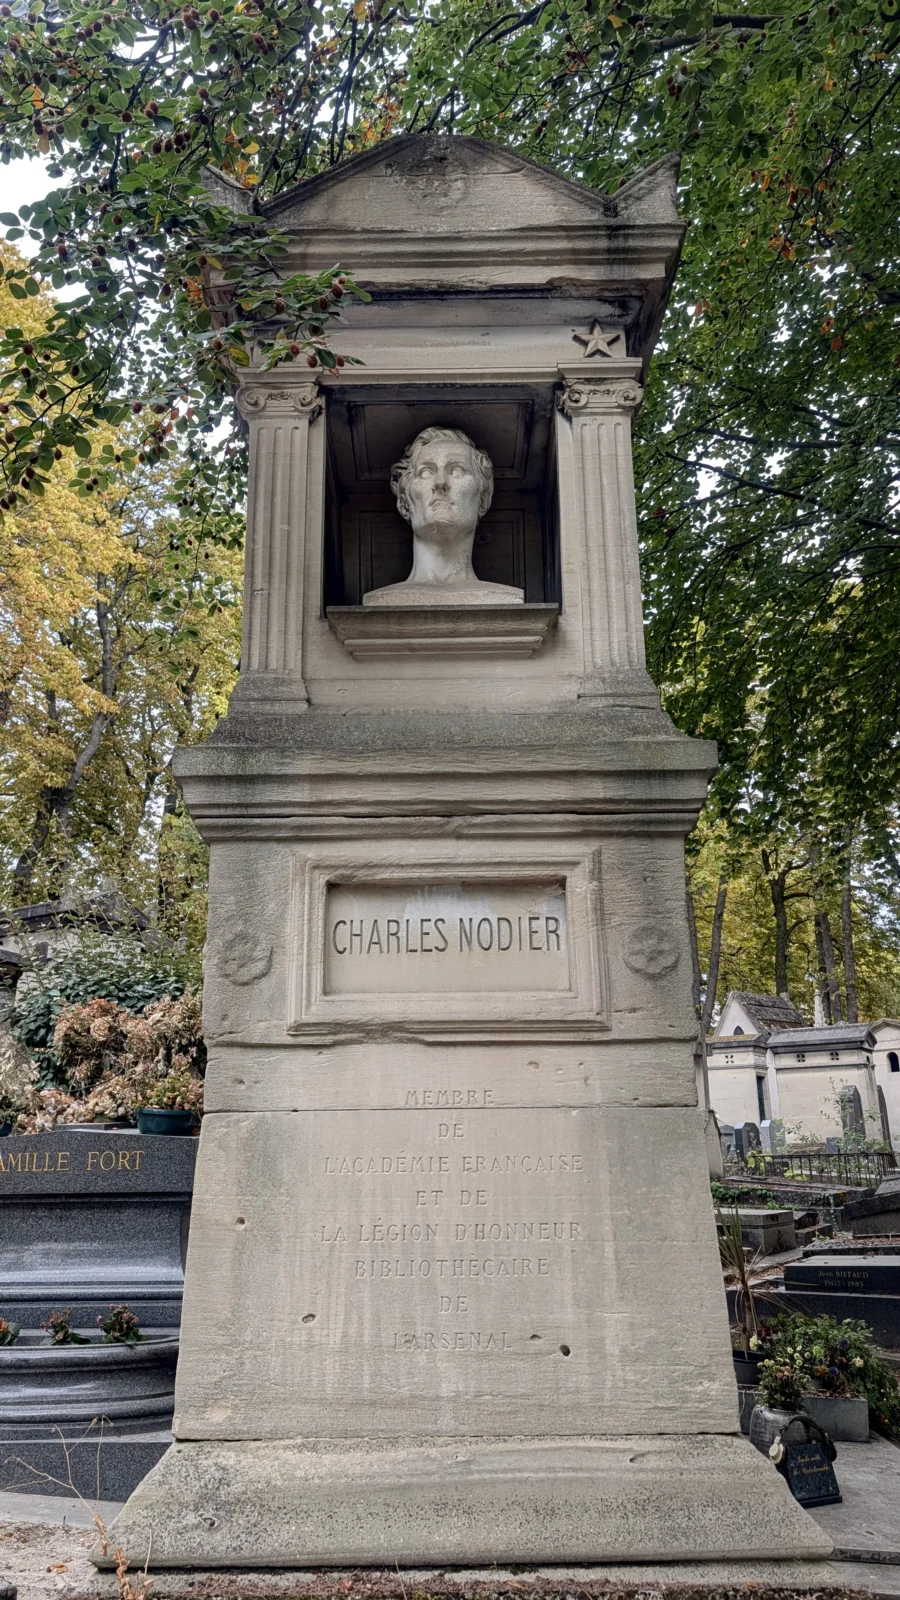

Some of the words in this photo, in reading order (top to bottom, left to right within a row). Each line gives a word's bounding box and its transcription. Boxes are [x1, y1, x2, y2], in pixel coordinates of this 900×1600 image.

[332, 917, 449, 955] CHARLES
[458, 916, 562, 953] NODIER
[404, 1090, 495, 1106] MEMBRE
[438, 1123, 464, 1138] DE
[86, 1150, 145, 1171] FORT
[324, 1151, 450, 1175] L'ACADÉMIE
[461, 1154, 583, 1174] FRANÇAISE
[415, 1190, 443, 1207] ET
[459, 1190, 488, 1206] DE
[319, 1225, 347, 1243] LA
[358, 1218, 439, 1243] LÉGION
[454, 1222, 583, 1242] D'HONNEUR
[354, 1253, 550, 1279] BIBLIOTHÉCAIRE
[818, 1270, 834, 1278] Jean
[835, 1270, 869, 1279] BIFFAUD
[439, 1295, 469, 1313] DE
[393, 1331, 513, 1351] L'ARSENAL
